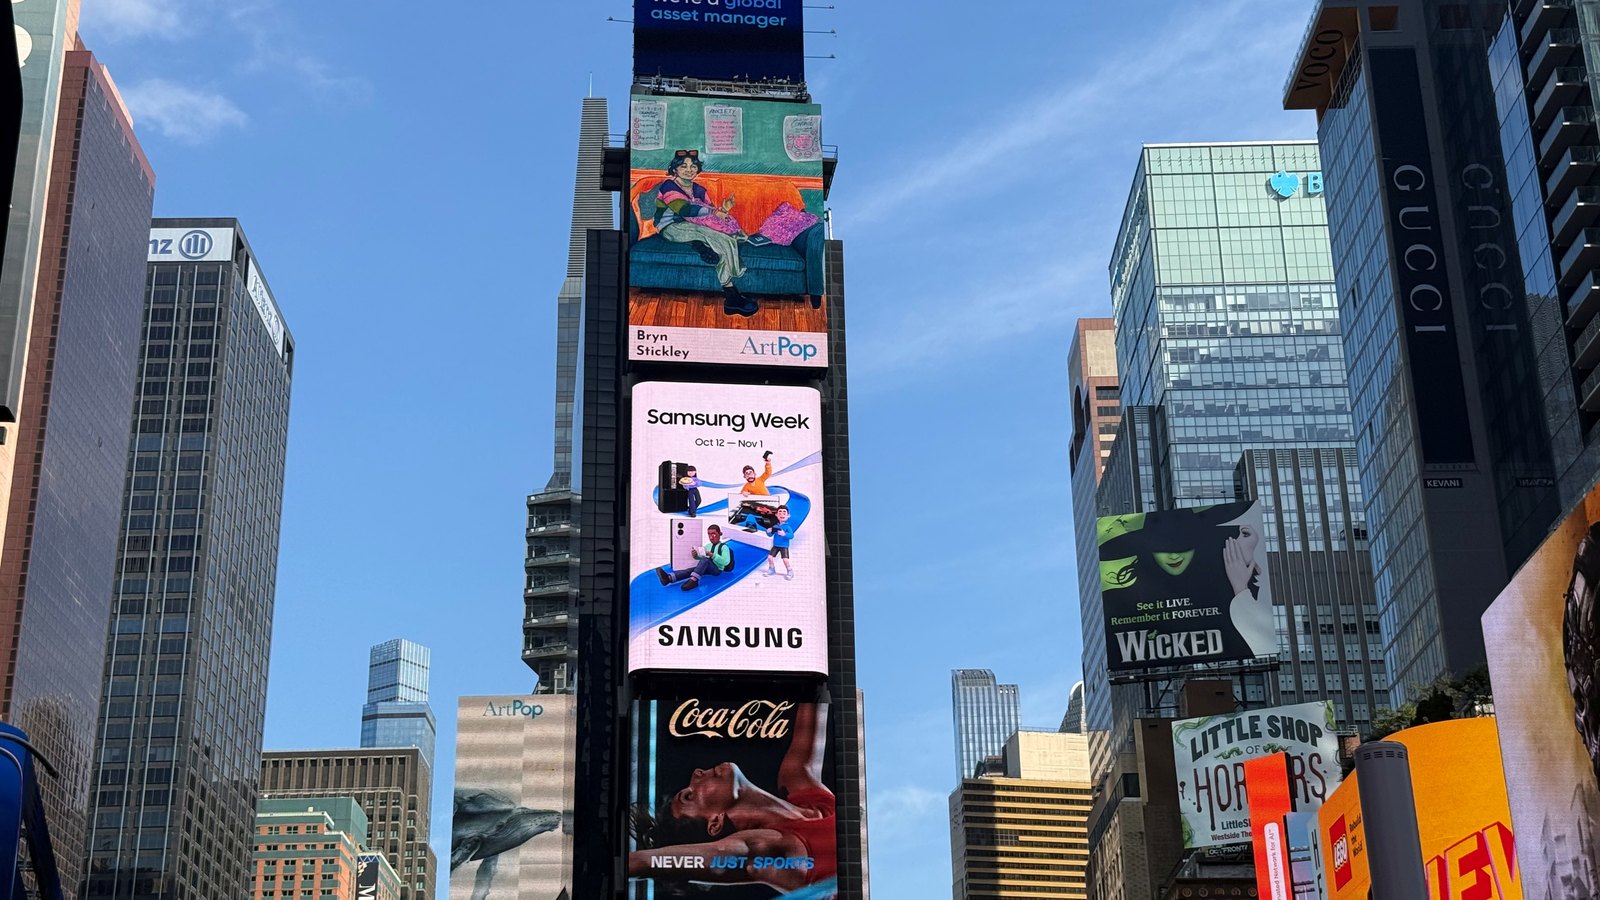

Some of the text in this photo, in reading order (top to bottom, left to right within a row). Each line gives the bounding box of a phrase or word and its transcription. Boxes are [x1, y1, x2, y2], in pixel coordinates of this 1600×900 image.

[724, 0, 782, 9] global
[651, 9, 787, 28] asset manager
[1393, 164, 1446, 333] GUCCI
[637, 330, 668, 346] Bryn
[636, 345, 690, 360] Stickley
[740, 336, 817, 361] ArtPop
[647, 409, 810, 432] Samsung Week
[695, 438, 714, 447] Oct
[715, 439, 725, 447] 12
[738, 439, 758, 448] Nov
[1427, 479, 1460, 487] KEVANI
[1136, 598, 1193, 610] See it LIVE.
[1111, 607, 1222, 625] Remember it FOREVER.
[658, 624, 803, 648] SAMSUNG
[482, 699, 544, 719] ArtPop
[669, 698, 795, 738] Coca-Cola
[1190, 714, 1323, 762] LITTLE SHOP
[1245, 745, 1261, 755] OF
[1193, 752, 1327, 828] HORRS
[1211, 832, 1240, 841] Westside
[1333, 833, 1348, 872] LEGO
[651, 855, 815, 870] NEVER JUST SPORTS
[1271, 852, 1279, 879] Network
